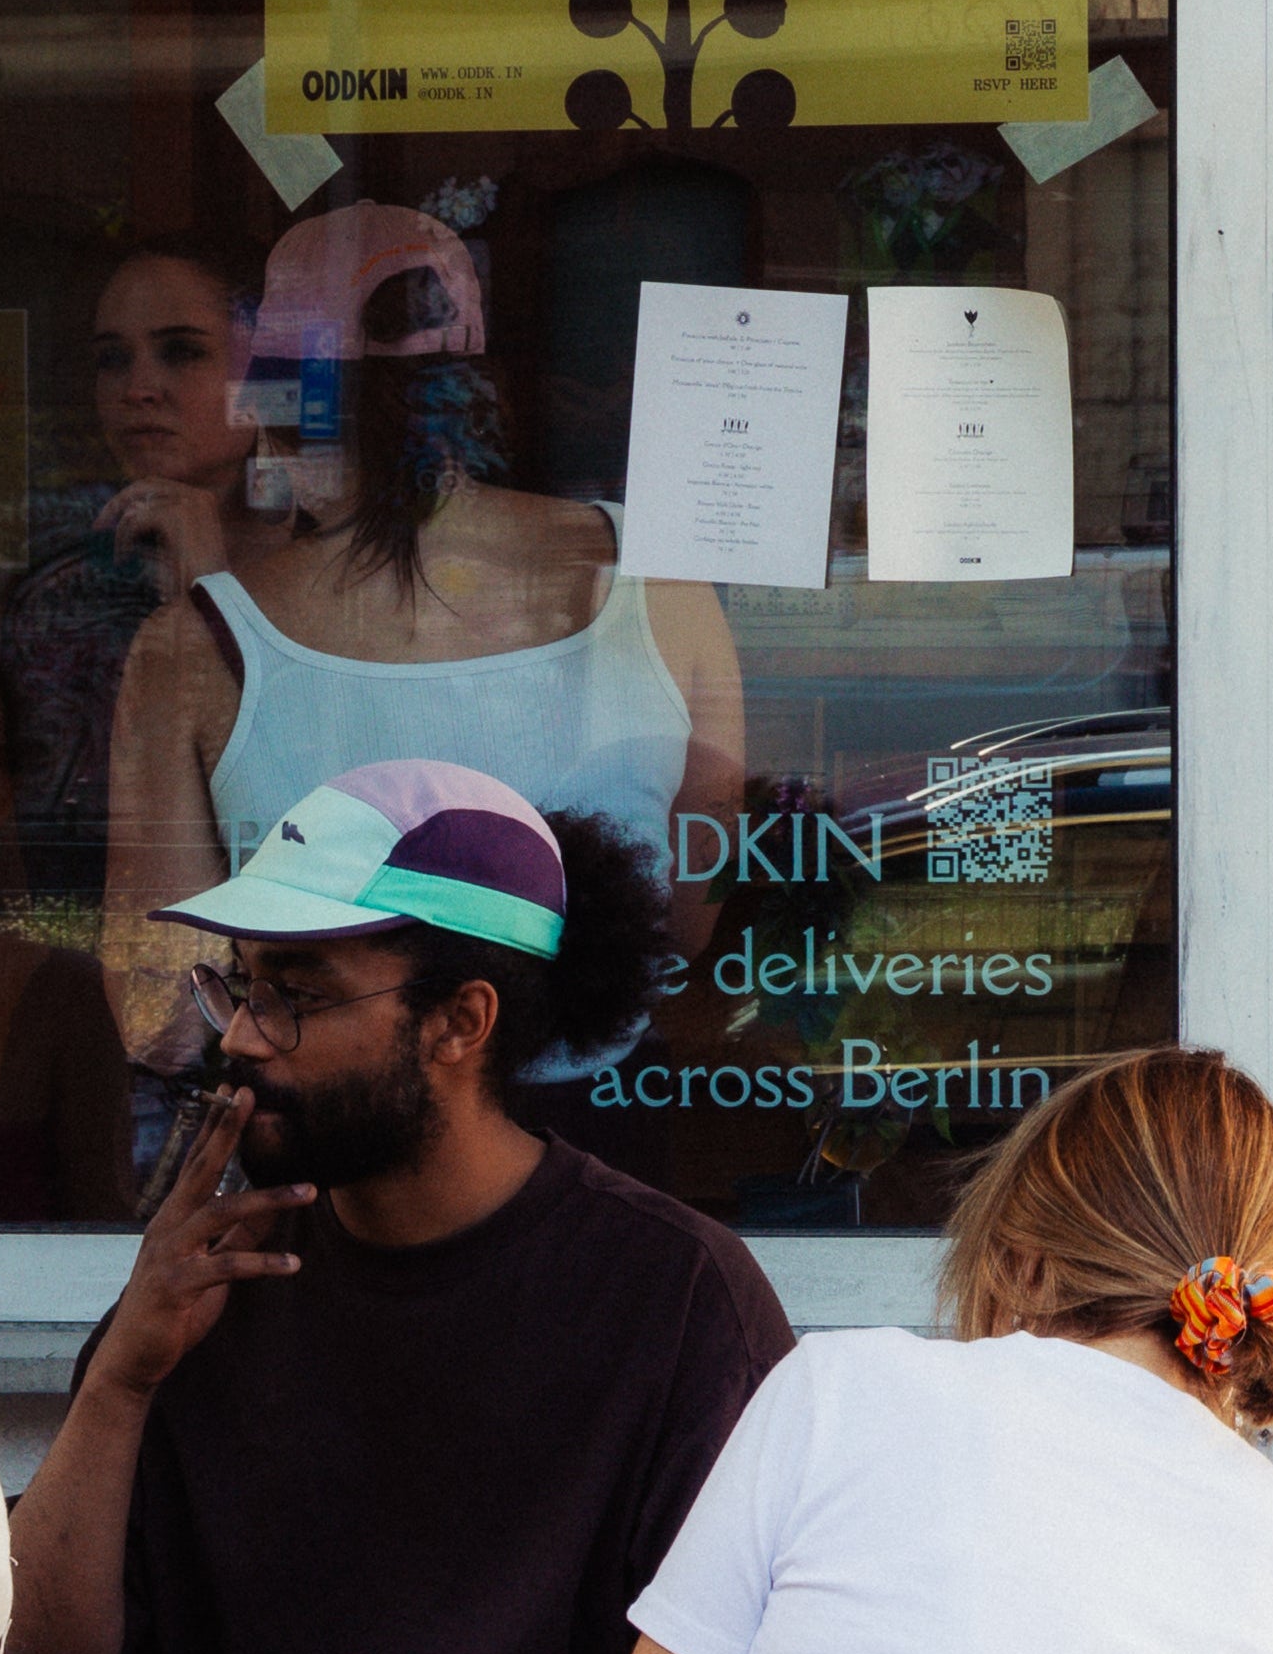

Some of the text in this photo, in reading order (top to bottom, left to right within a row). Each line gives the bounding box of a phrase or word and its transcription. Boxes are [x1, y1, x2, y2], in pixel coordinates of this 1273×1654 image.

[303, 67, 407, 101] ODDKIN
[421, 67, 522, 79] WWW.ODDK.IN
[974, 78, 1057, 91] RSVP HERE
[418, 87, 492, 100] @ODDK.IN
[675, 811, 885, 884] DKIN
[712, 924, 1054, 997] deliveries
[589, 1036, 1051, 1110] across Berlin
